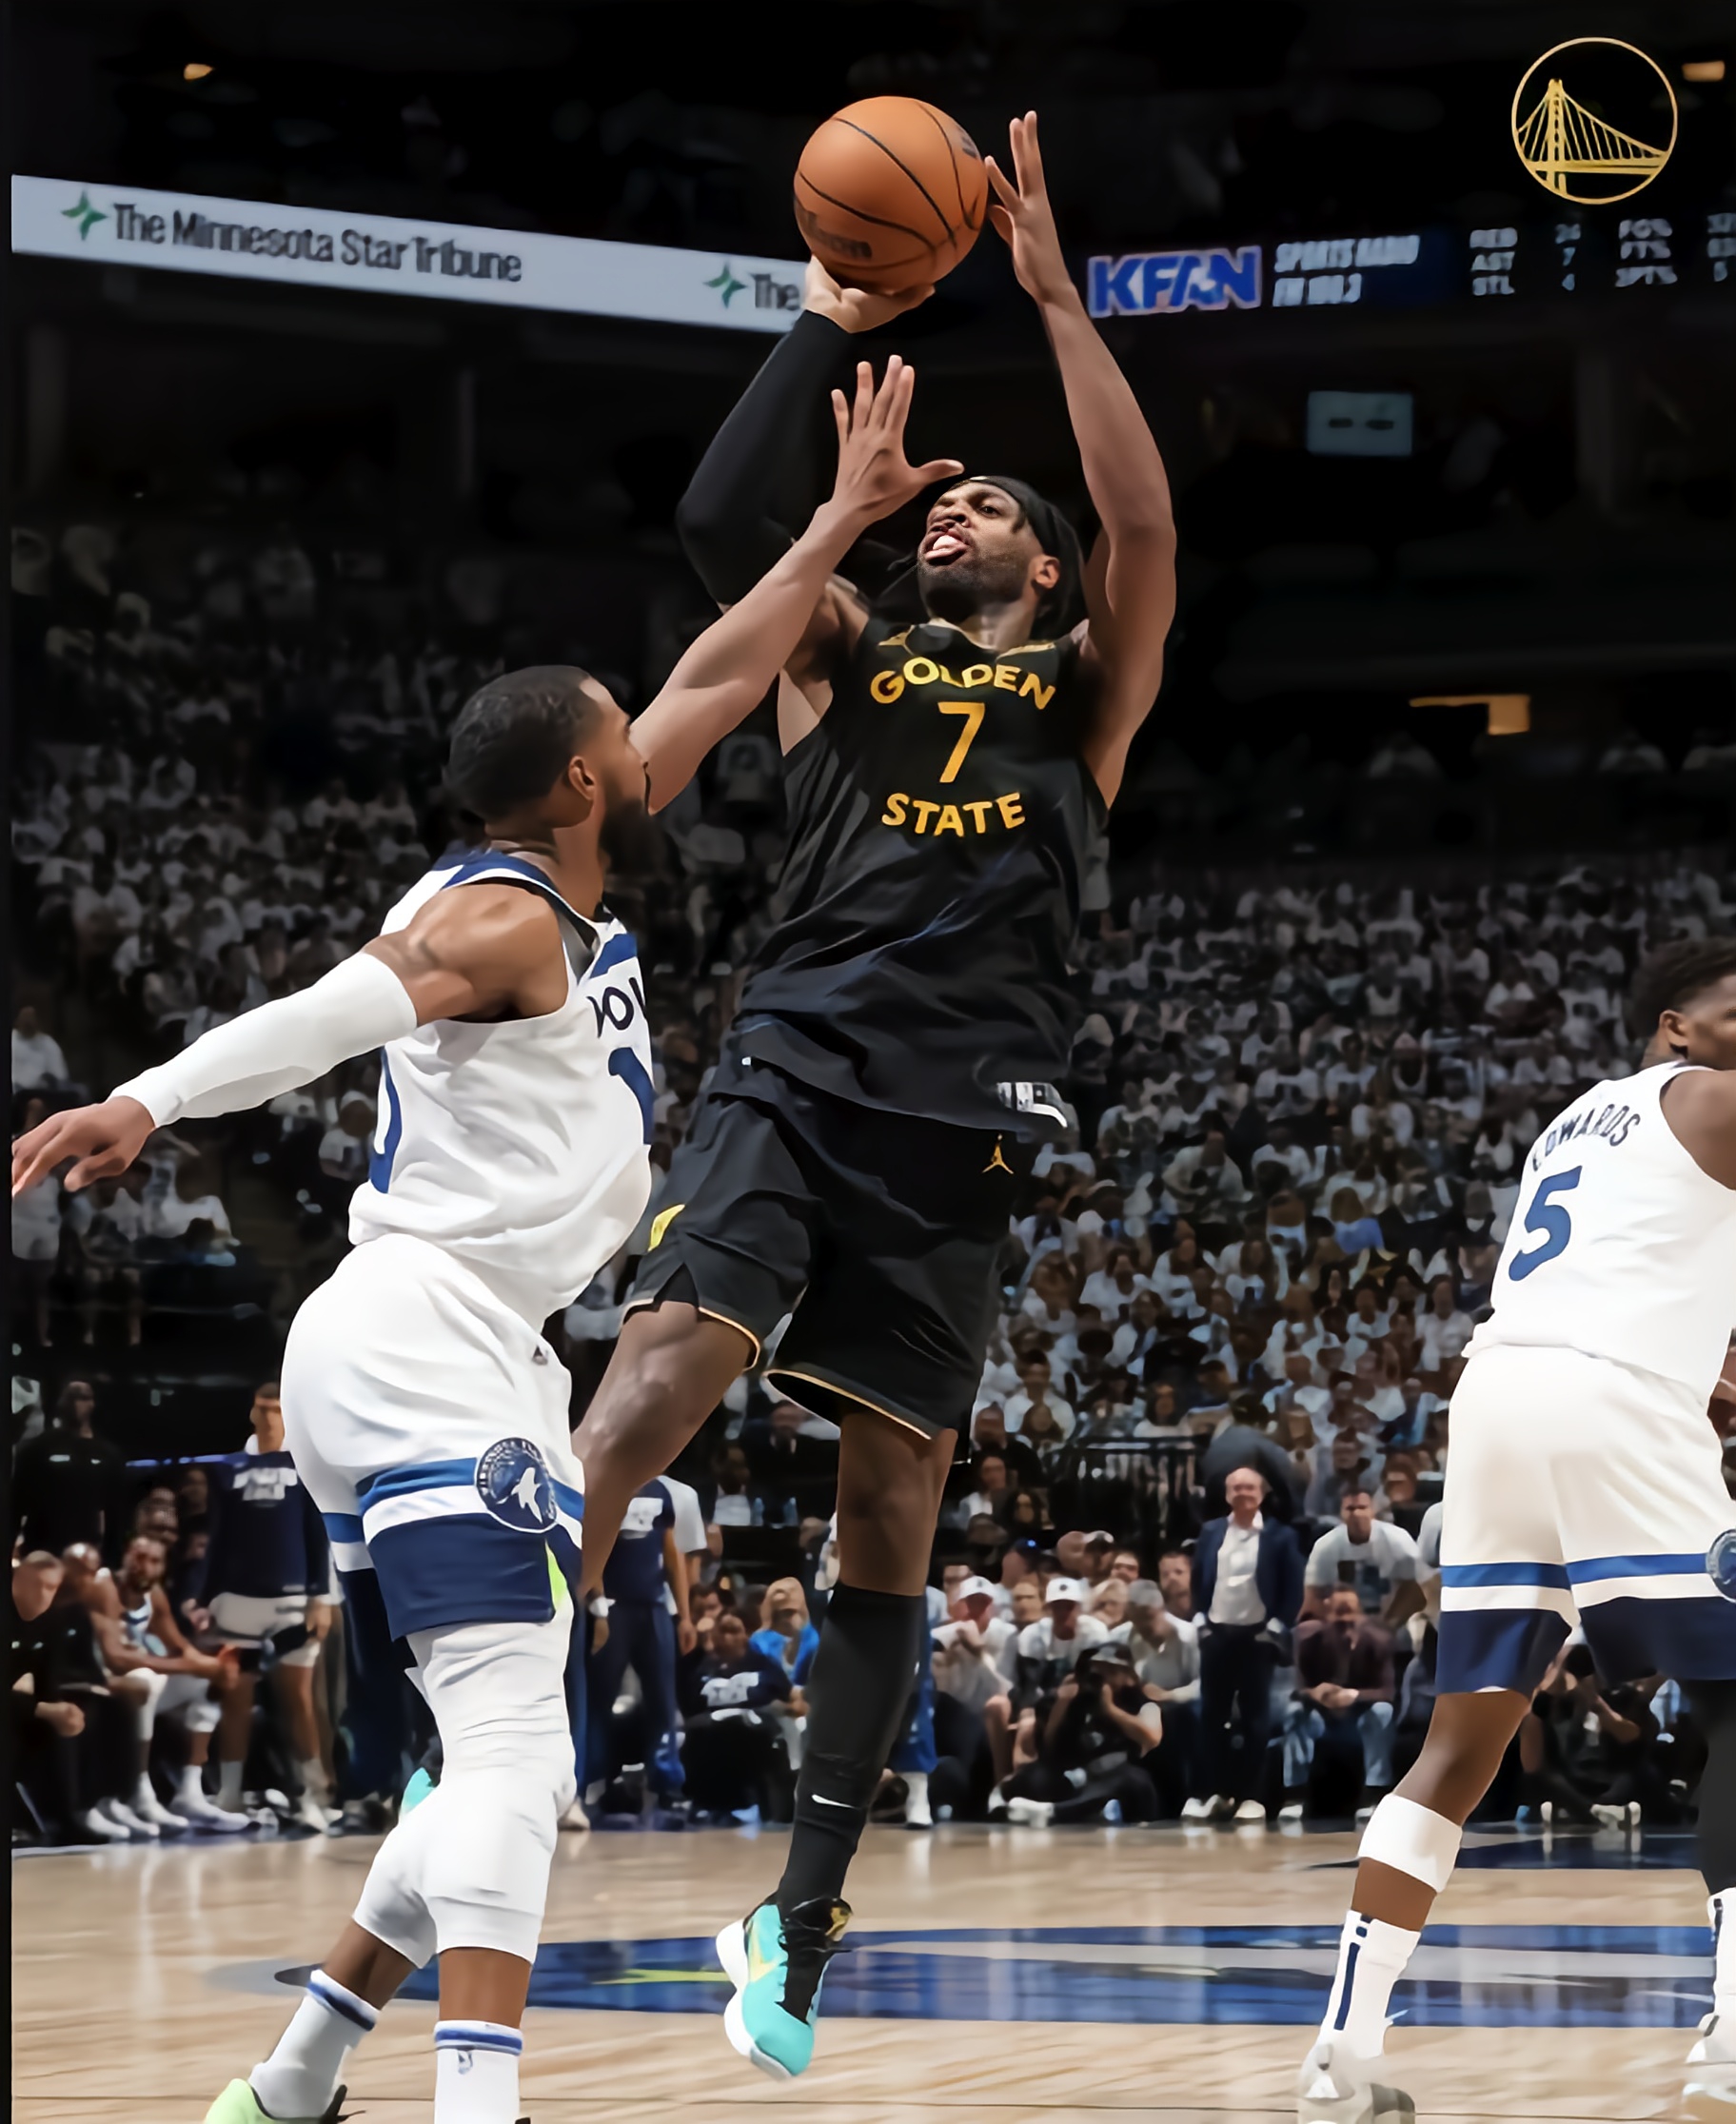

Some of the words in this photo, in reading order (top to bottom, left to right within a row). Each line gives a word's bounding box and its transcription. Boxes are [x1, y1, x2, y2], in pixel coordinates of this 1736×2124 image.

[113, 203, 166, 245] The
[172, 209, 334, 263] Minnesota
[341, 228, 409, 271] Star
[412, 236, 523, 283] Tribune
[750, 273, 801, 310] The
[1089, 246, 1262, 318] KFAN
[869, 656, 1056, 711] GOLDEN
[937, 700, 986, 784] 7
[880, 791, 1026, 838] STATE
[1508, 1164, 1584, 1282] 5
